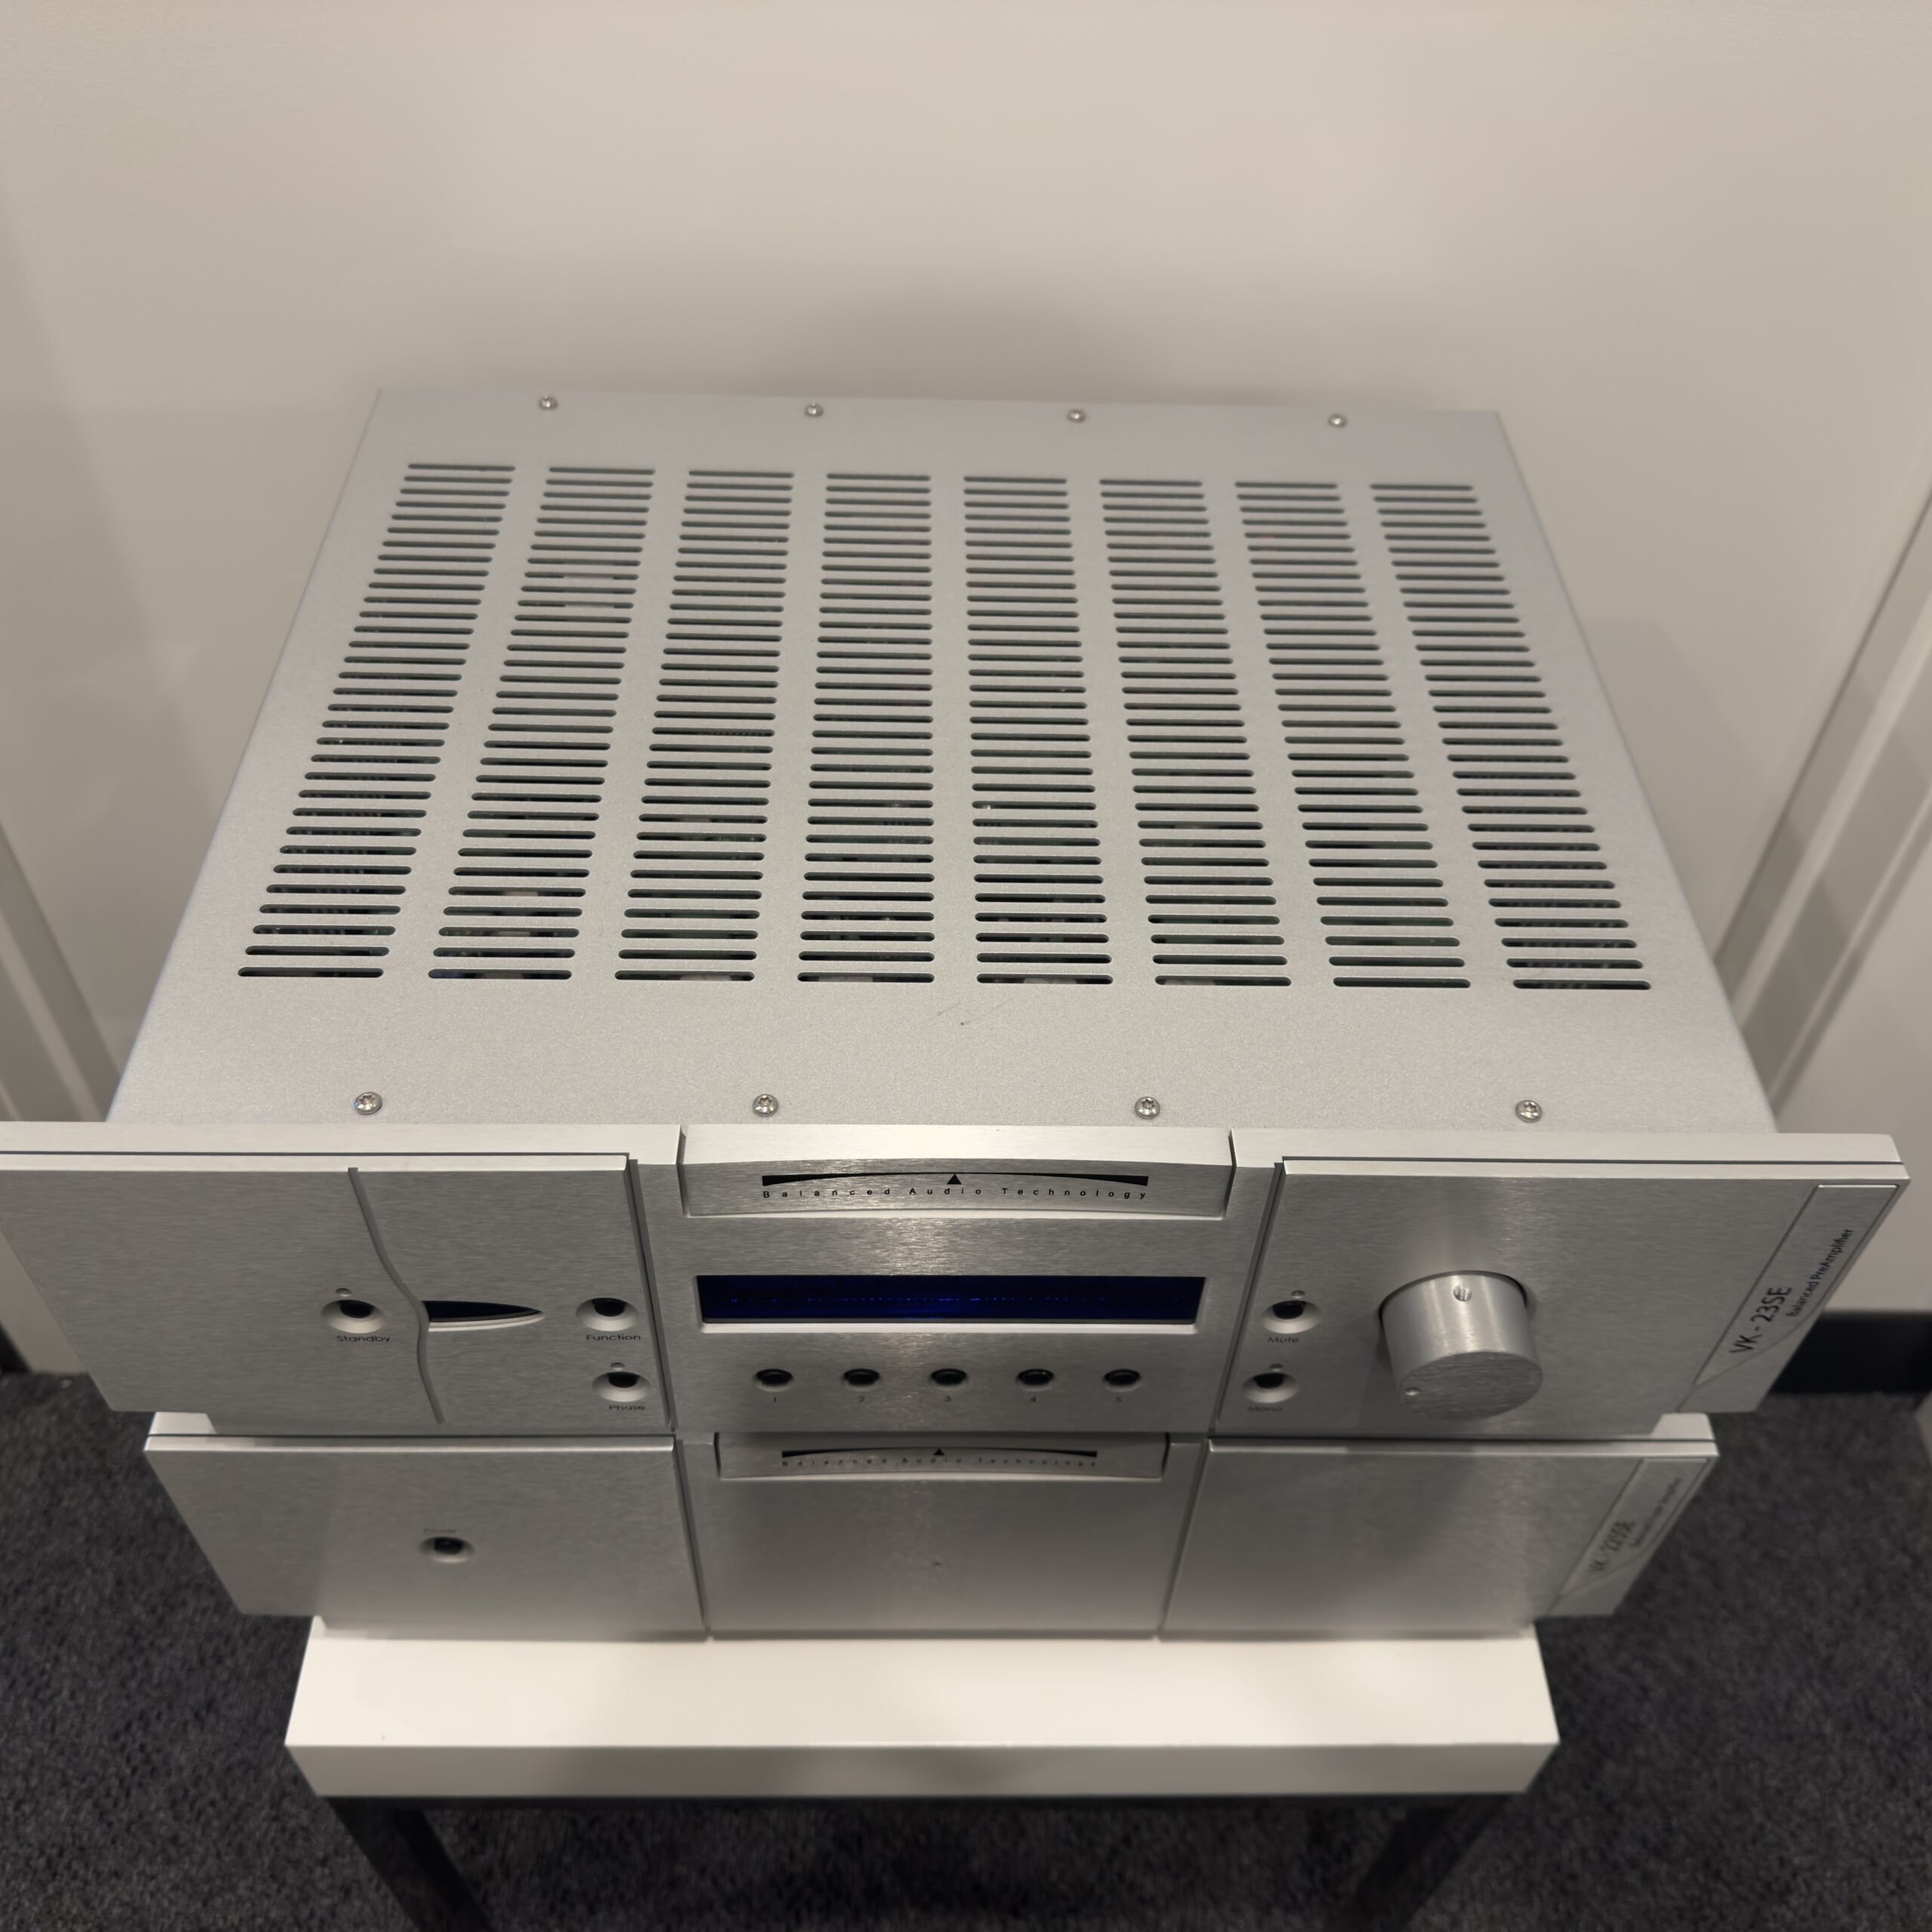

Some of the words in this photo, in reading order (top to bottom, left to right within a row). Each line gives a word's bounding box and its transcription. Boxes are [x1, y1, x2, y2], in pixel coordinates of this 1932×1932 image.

[762, 1188, 891, 1198] Balanced
[909, 1187, 982, 1195] Audio
[1001, 1187, 1146, 1200] Technology
